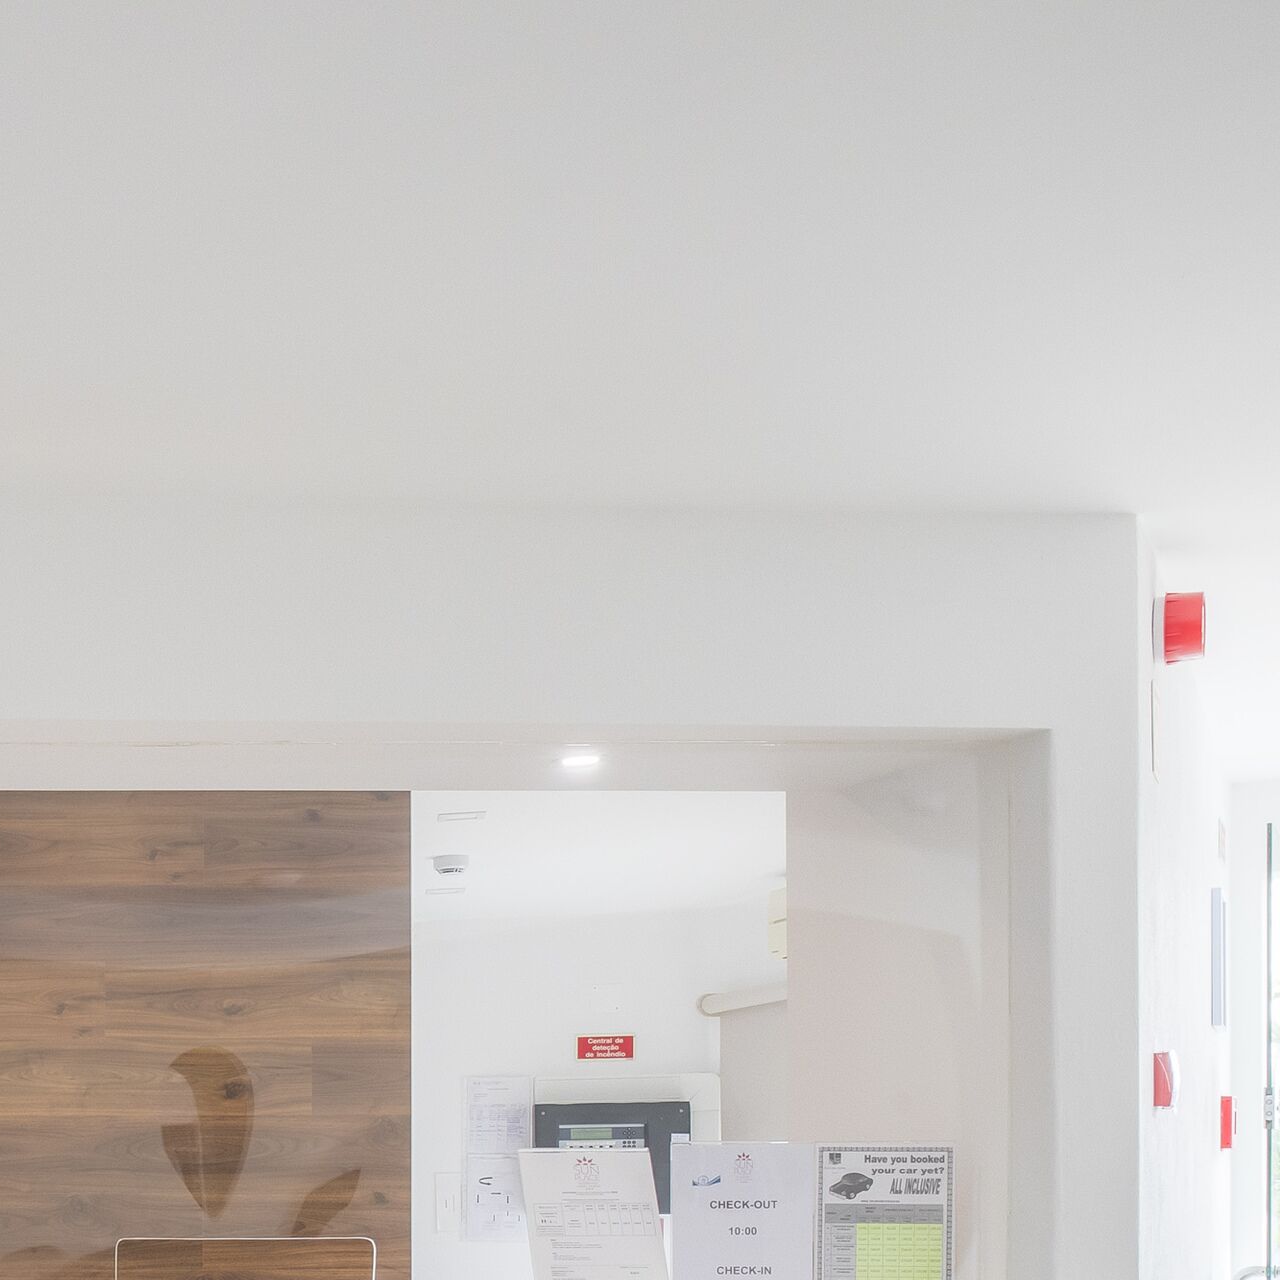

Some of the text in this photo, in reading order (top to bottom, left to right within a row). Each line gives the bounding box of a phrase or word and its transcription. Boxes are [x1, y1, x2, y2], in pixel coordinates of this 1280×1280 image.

[864, 1154, 945, 1166] Have you booked
[871, 1167, 896, 1176] your
[920, 1166, 945, 1176] yet?
[889, 1178, 941, 1195] ALL INCLUSIVE
[709, 1200, 778, 1210] CHECK-OUT
[728, 1227, 758, 1236] 10:00
[716, 1266, 772, 1275] CHECK-IN
